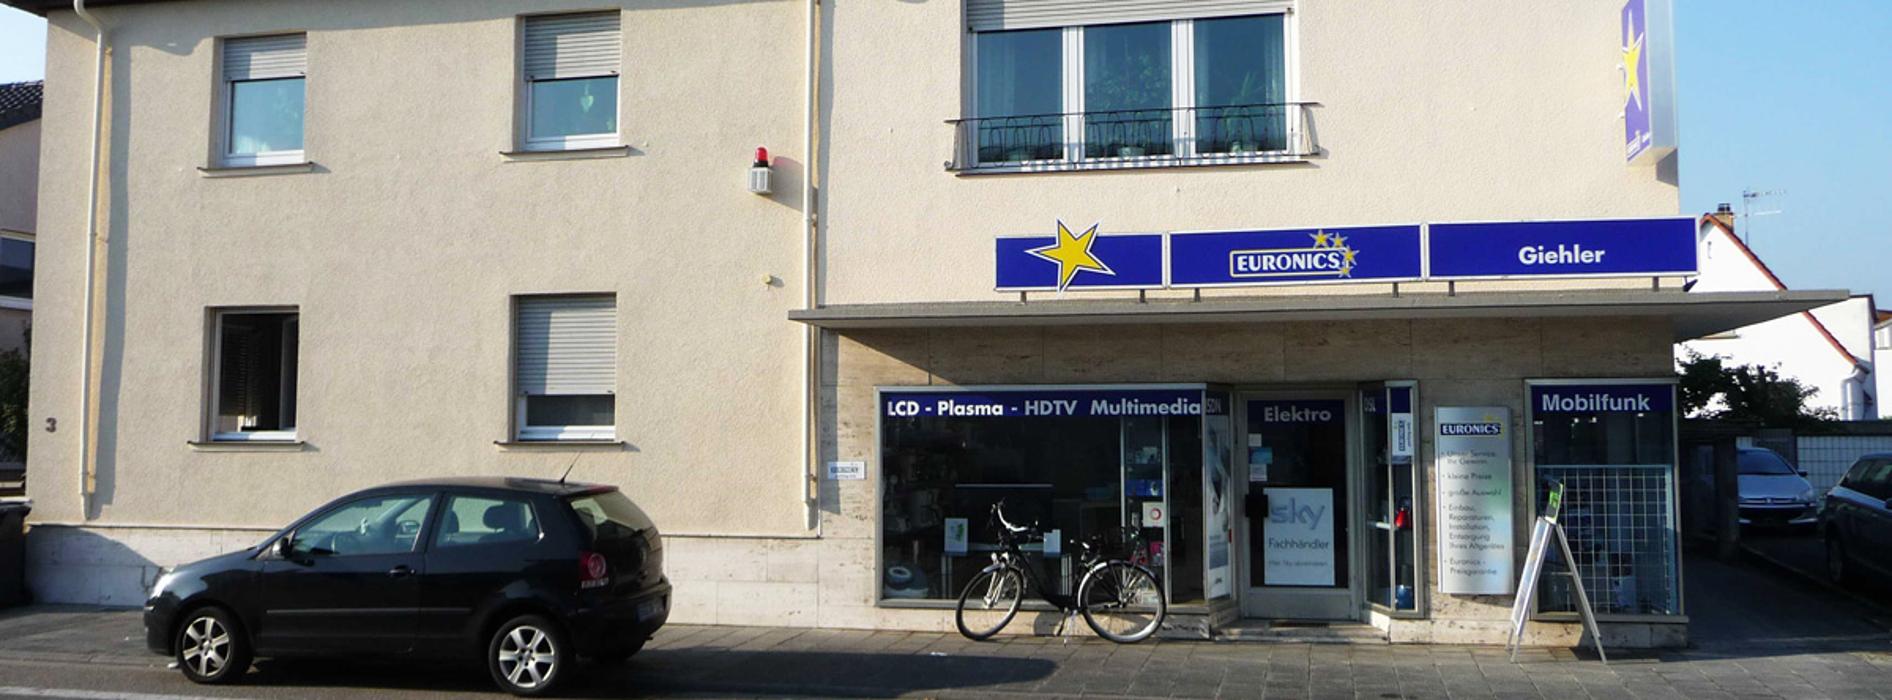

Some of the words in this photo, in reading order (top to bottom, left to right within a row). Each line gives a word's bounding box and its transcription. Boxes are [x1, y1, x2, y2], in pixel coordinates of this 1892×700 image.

[1237, 253, 1340, 272] EURONICS
[1518, 244, 1605, 265] Giehler
[887, 401, 919, 416] LCD
[937, 400, 1003, 416] Plasma
[1025, 401, 1077, 416] HDTV
[1090, 398, 1201, 416] Multimedia
[1542, 393, 1650, 411] Mobilfunk
[1264, 405, 1332, 421] Elektro
[45, 417, 57, 433] 3
[1442, 424, 1499, 434] EURONICS
[1271, 497, 1325, 530] sky
[1268, 538, 1328, 550] Fachhändler
